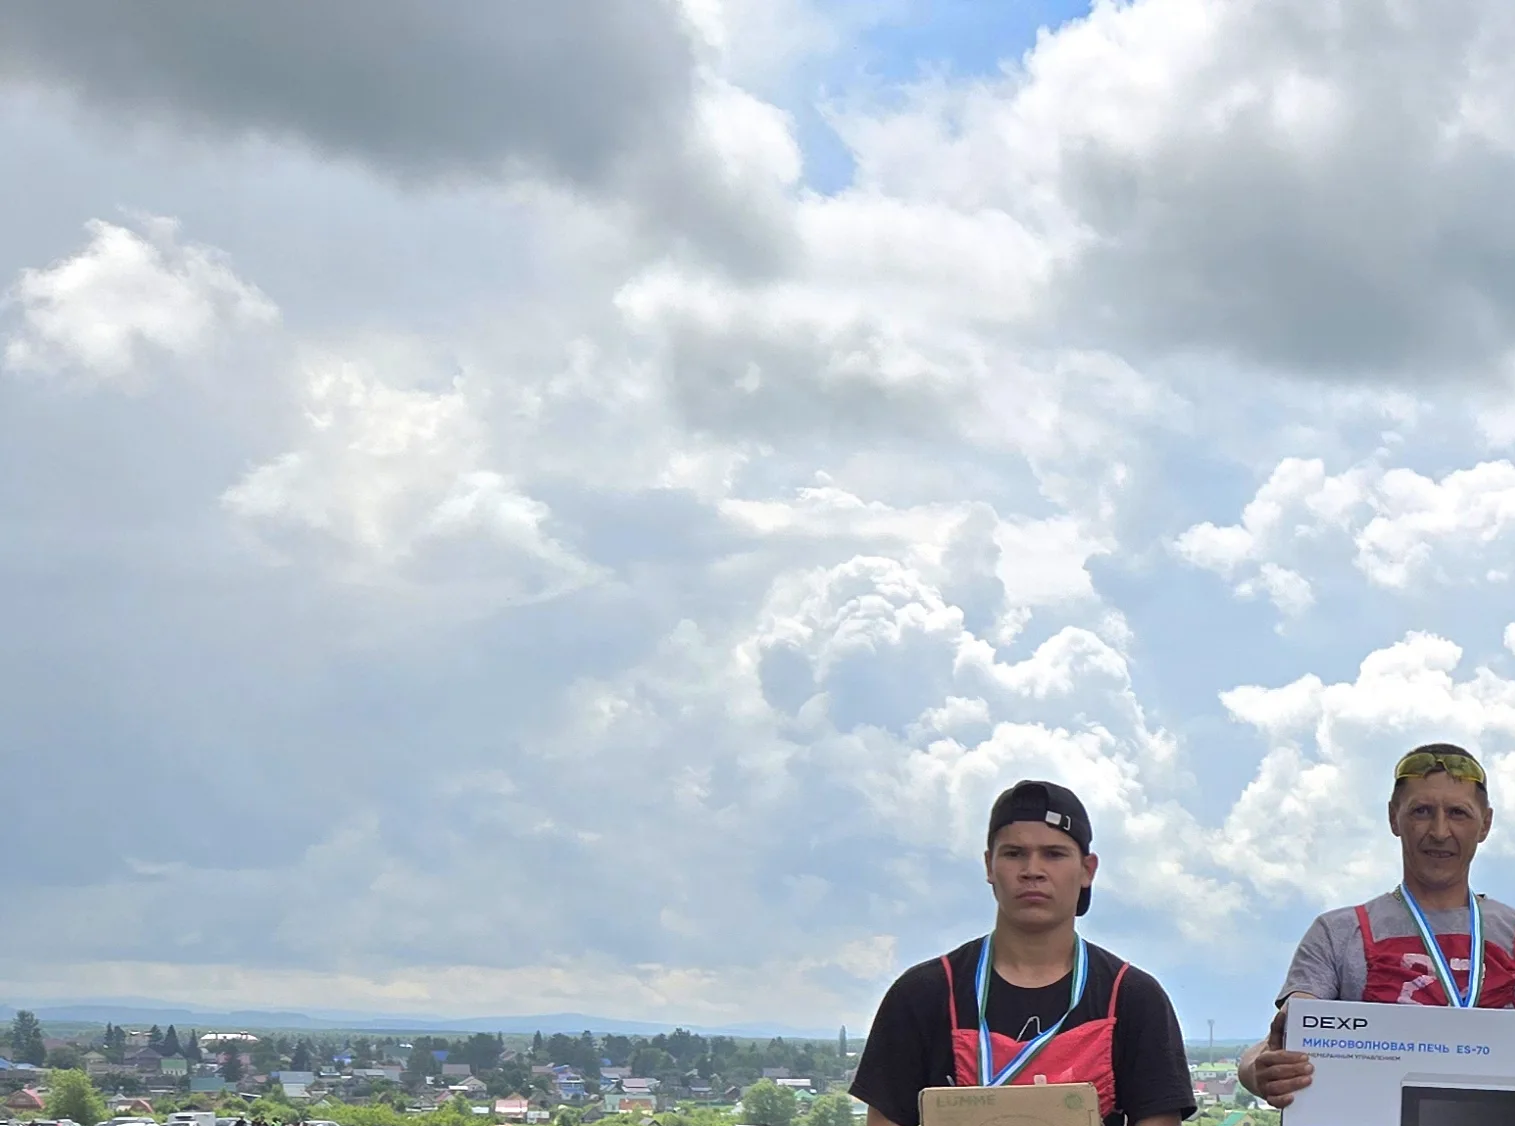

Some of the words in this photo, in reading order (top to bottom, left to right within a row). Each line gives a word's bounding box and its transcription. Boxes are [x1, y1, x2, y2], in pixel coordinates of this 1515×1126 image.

[1303, 1016, 1368, 1030] DEXP
[1302, 1038, 1415, 1052] МИКРОВОЛНОВАЯ
[1418, 1043, 1450, 1053] ПЕЧЬ
[1457, 1046, 1490, 1055] ES-70
